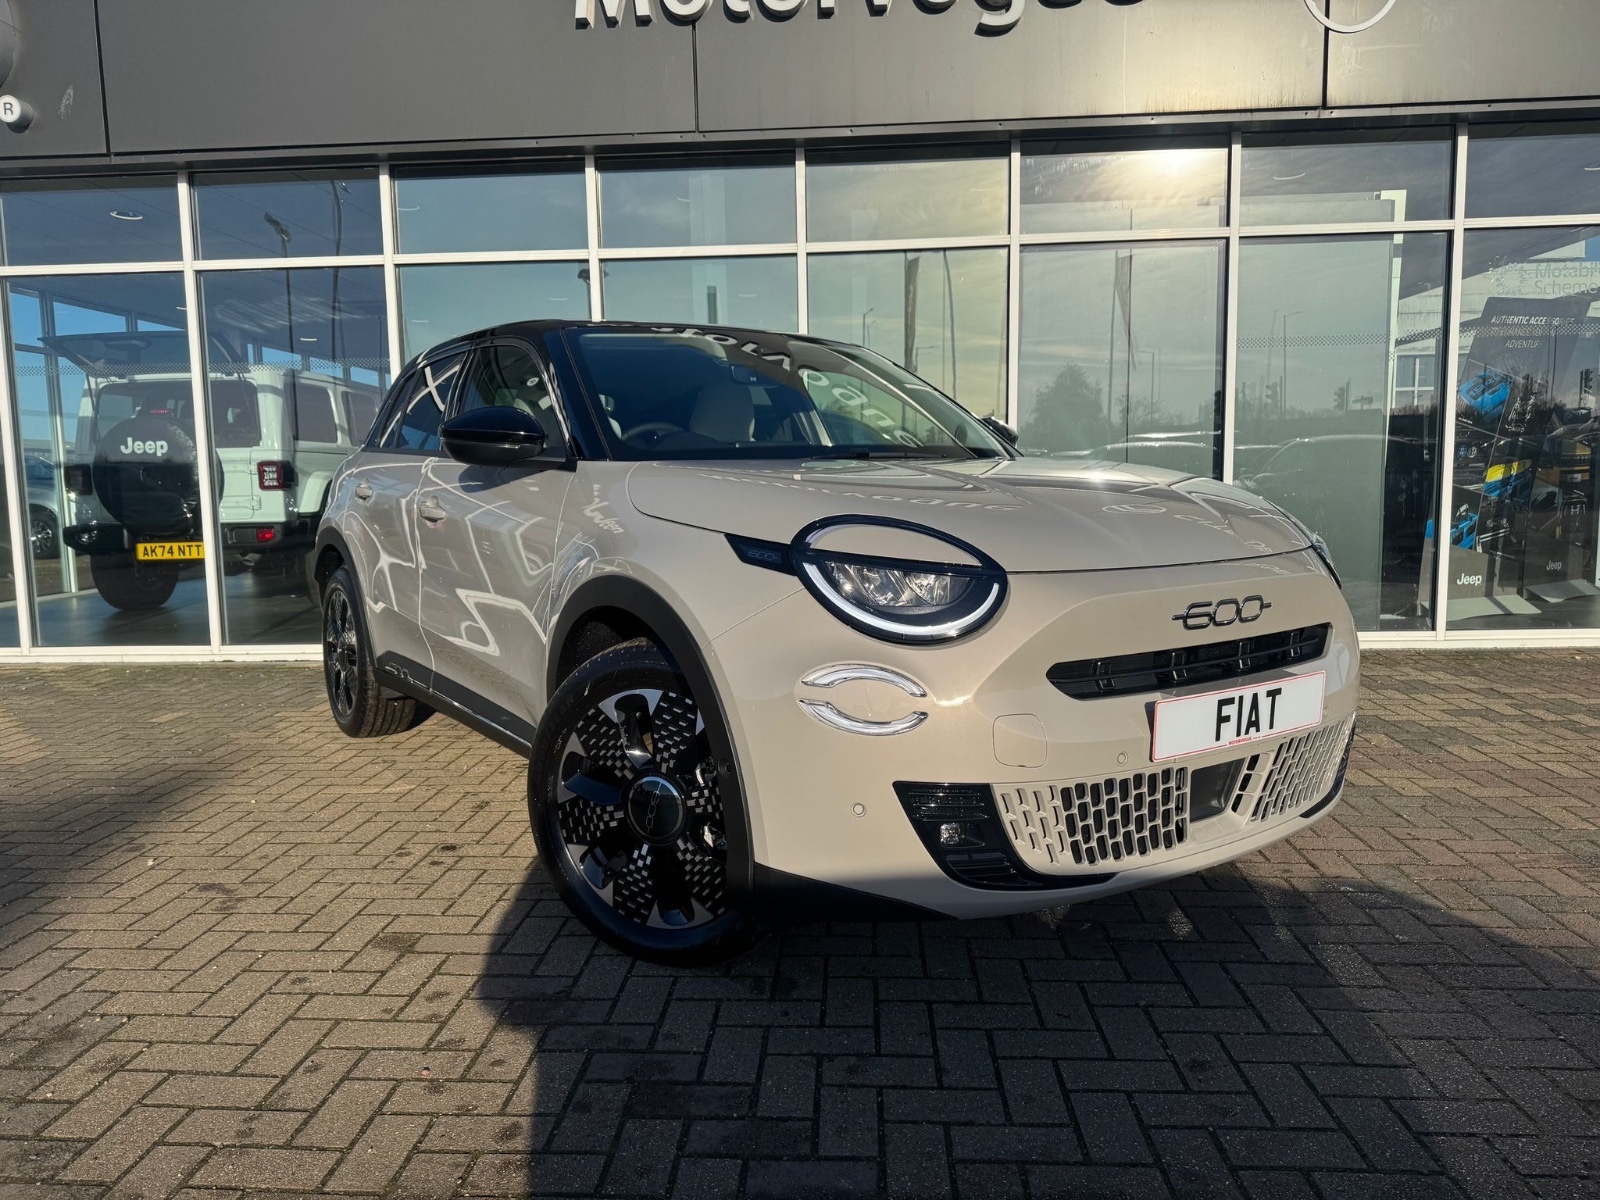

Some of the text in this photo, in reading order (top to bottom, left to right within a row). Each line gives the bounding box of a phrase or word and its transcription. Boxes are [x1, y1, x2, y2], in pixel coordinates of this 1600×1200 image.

[1535, 262, 1600, 279] Motabil
[1534, 280, 1598, 295] Scheme
[1490, 315, 1528, 325] AUTHENTIC
[120, 437, 168, 456] Jeep
[142, 544, 202, 558] AK74 NTT
[747, 549, 778, 561] 600
[1546, 560, 1562, 571] Jeep
[1456, 573, 1482, 587] Jeep
[1172, 594, 1272, 631] 600
[1215, 687, 1282, 742] FIAT
